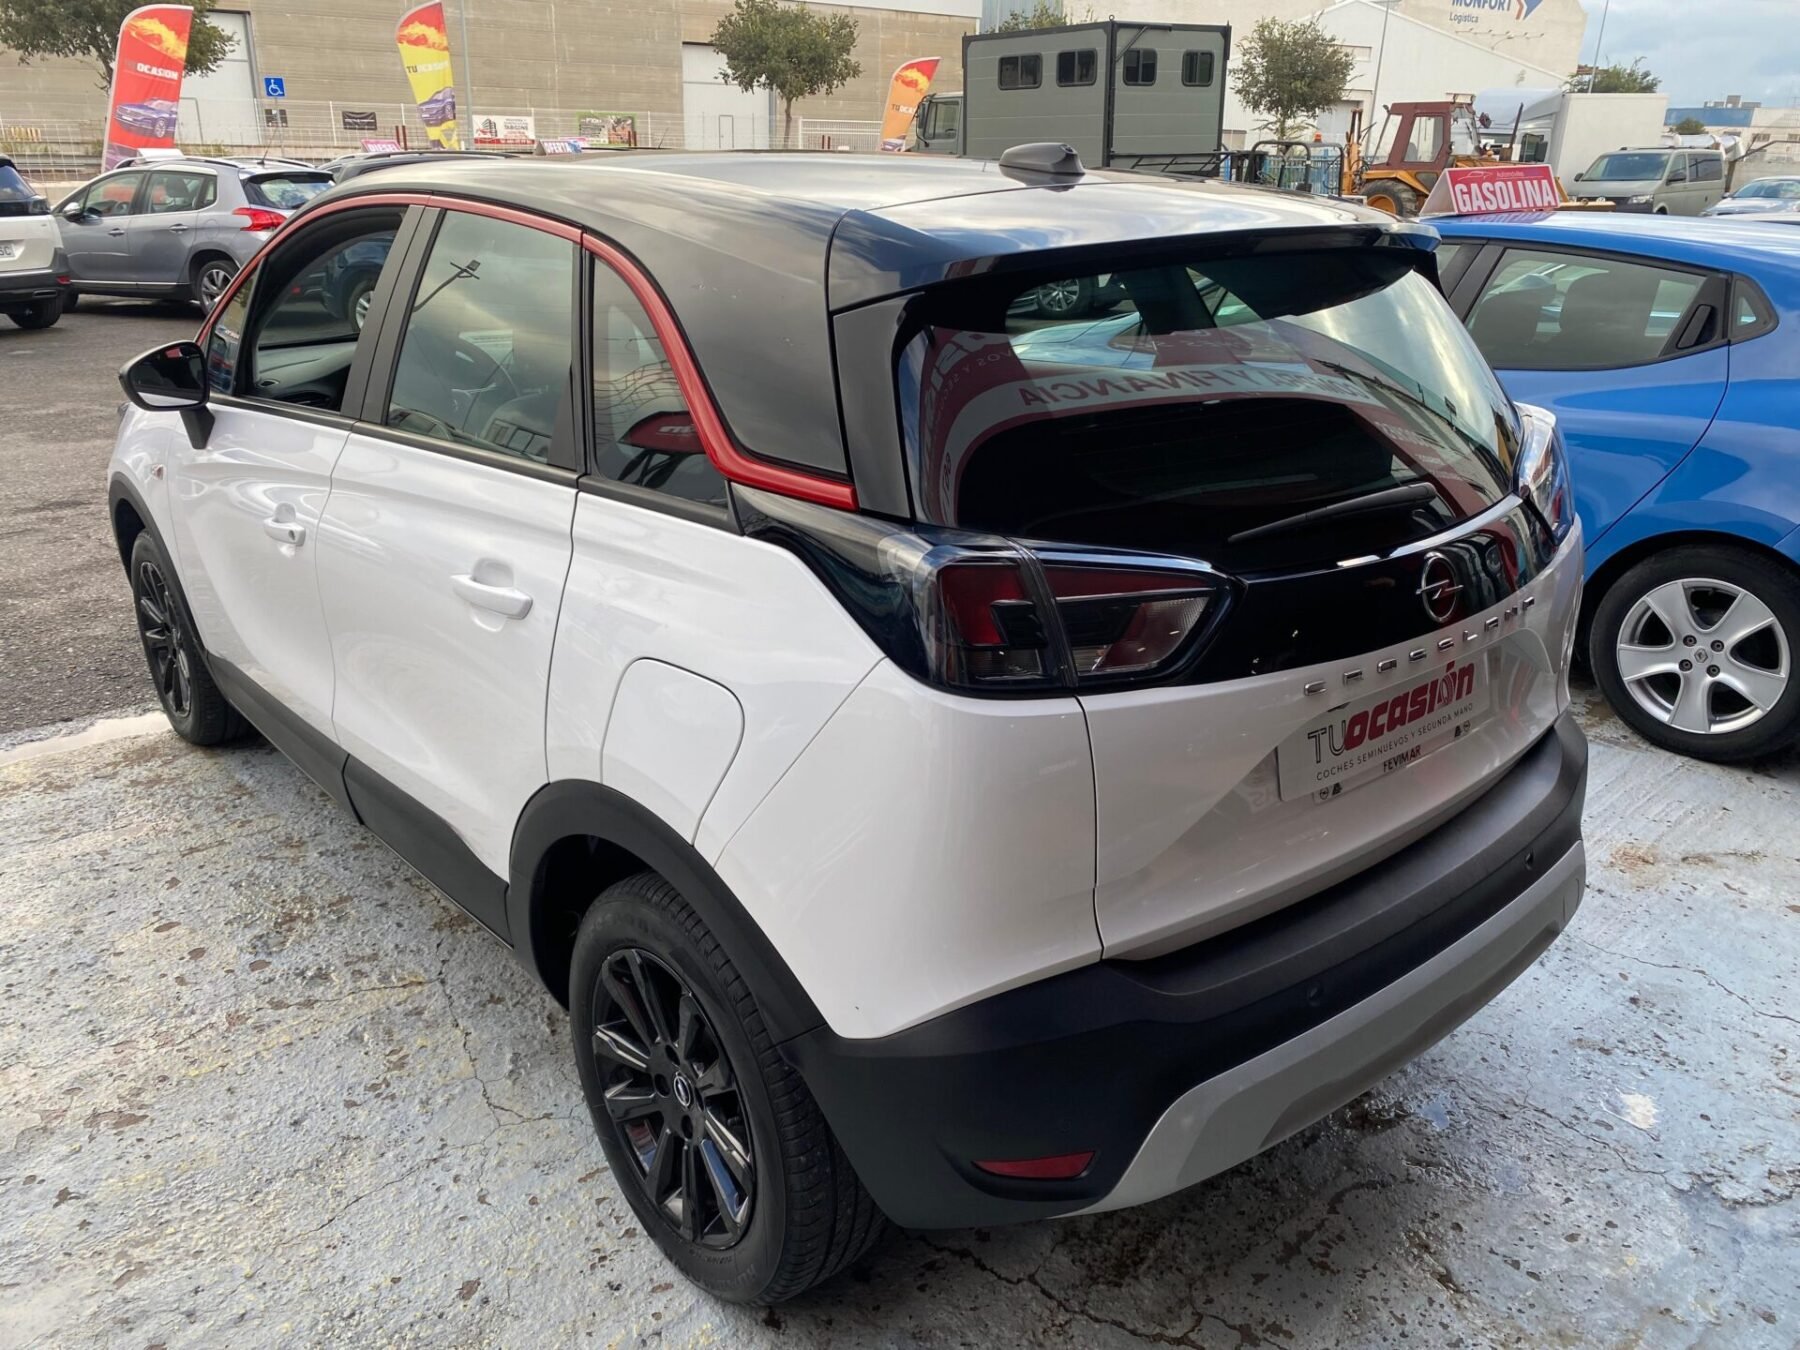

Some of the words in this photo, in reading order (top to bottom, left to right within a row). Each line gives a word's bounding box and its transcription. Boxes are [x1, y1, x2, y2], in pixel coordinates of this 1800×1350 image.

[1454, 180, 1556, 212] GASOLINA
[1316, 760, 1354, 781] COCHES
[1357, 734, 1409, 764] SEMINUEVOS
[1410, 731, 1416, 740] Y
[1418, 714, 1452, 736] SEGUNDA
[1453, 702, 1474, 721] MANO
[1383, 745, 1421, 773] FEVIMAR
